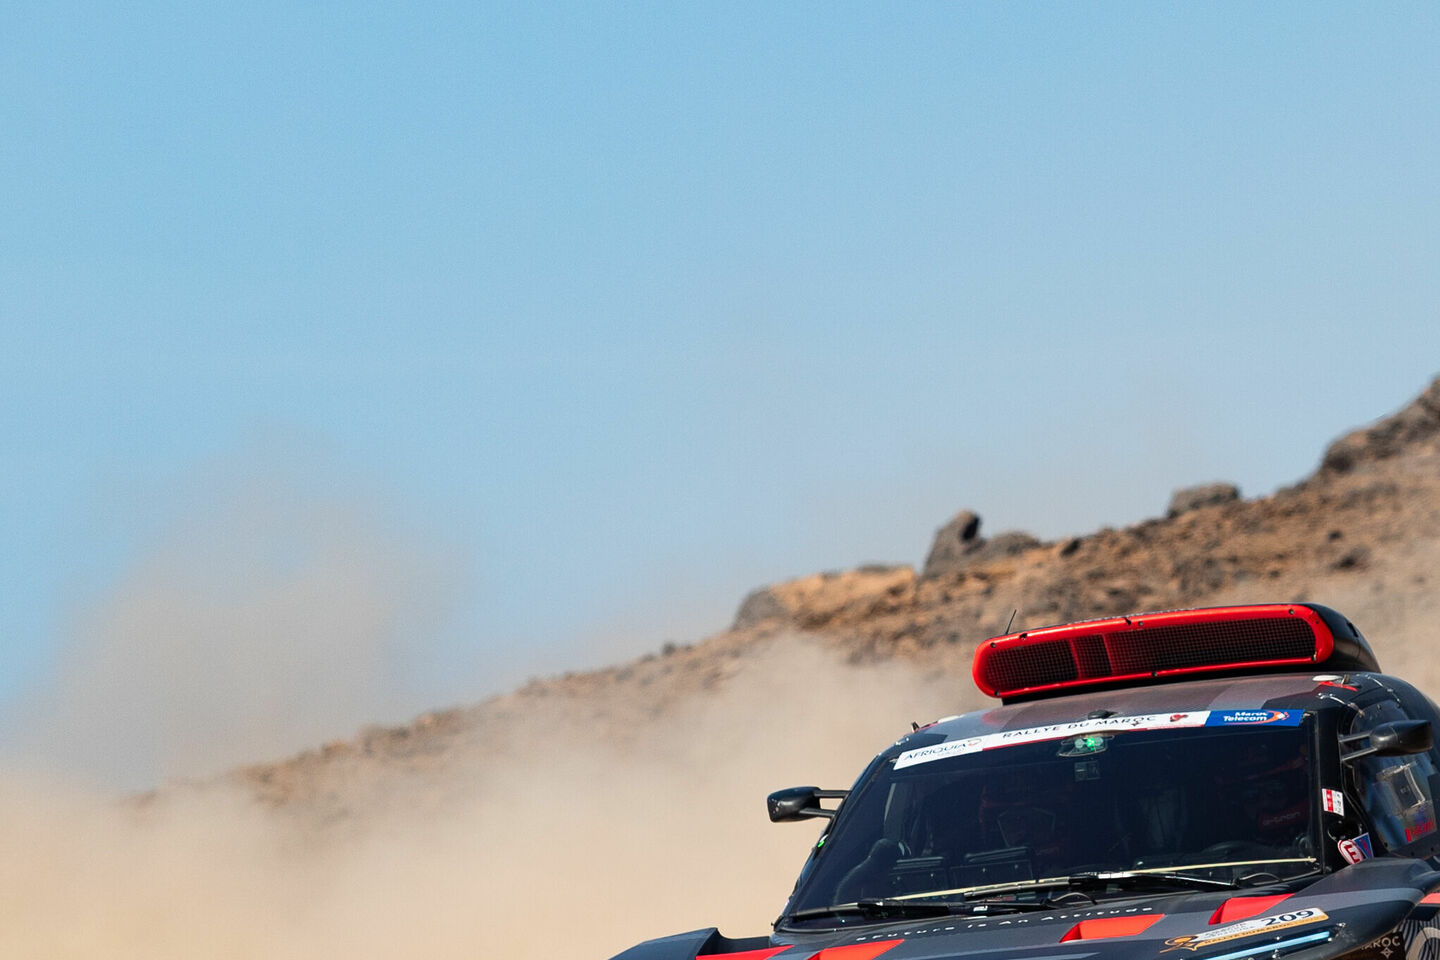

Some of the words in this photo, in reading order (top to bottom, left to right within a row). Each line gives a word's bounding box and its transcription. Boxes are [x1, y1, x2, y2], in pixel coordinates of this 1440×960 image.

[1002, 725, 1059, 739] RALLYE
[1067, 721, 1090, 730] DU
[1094, 715, 1157, 727] MAROC
[904, 742, 967, 761] AFRIQUIA
[1260, 909, 1315, 926] 209
